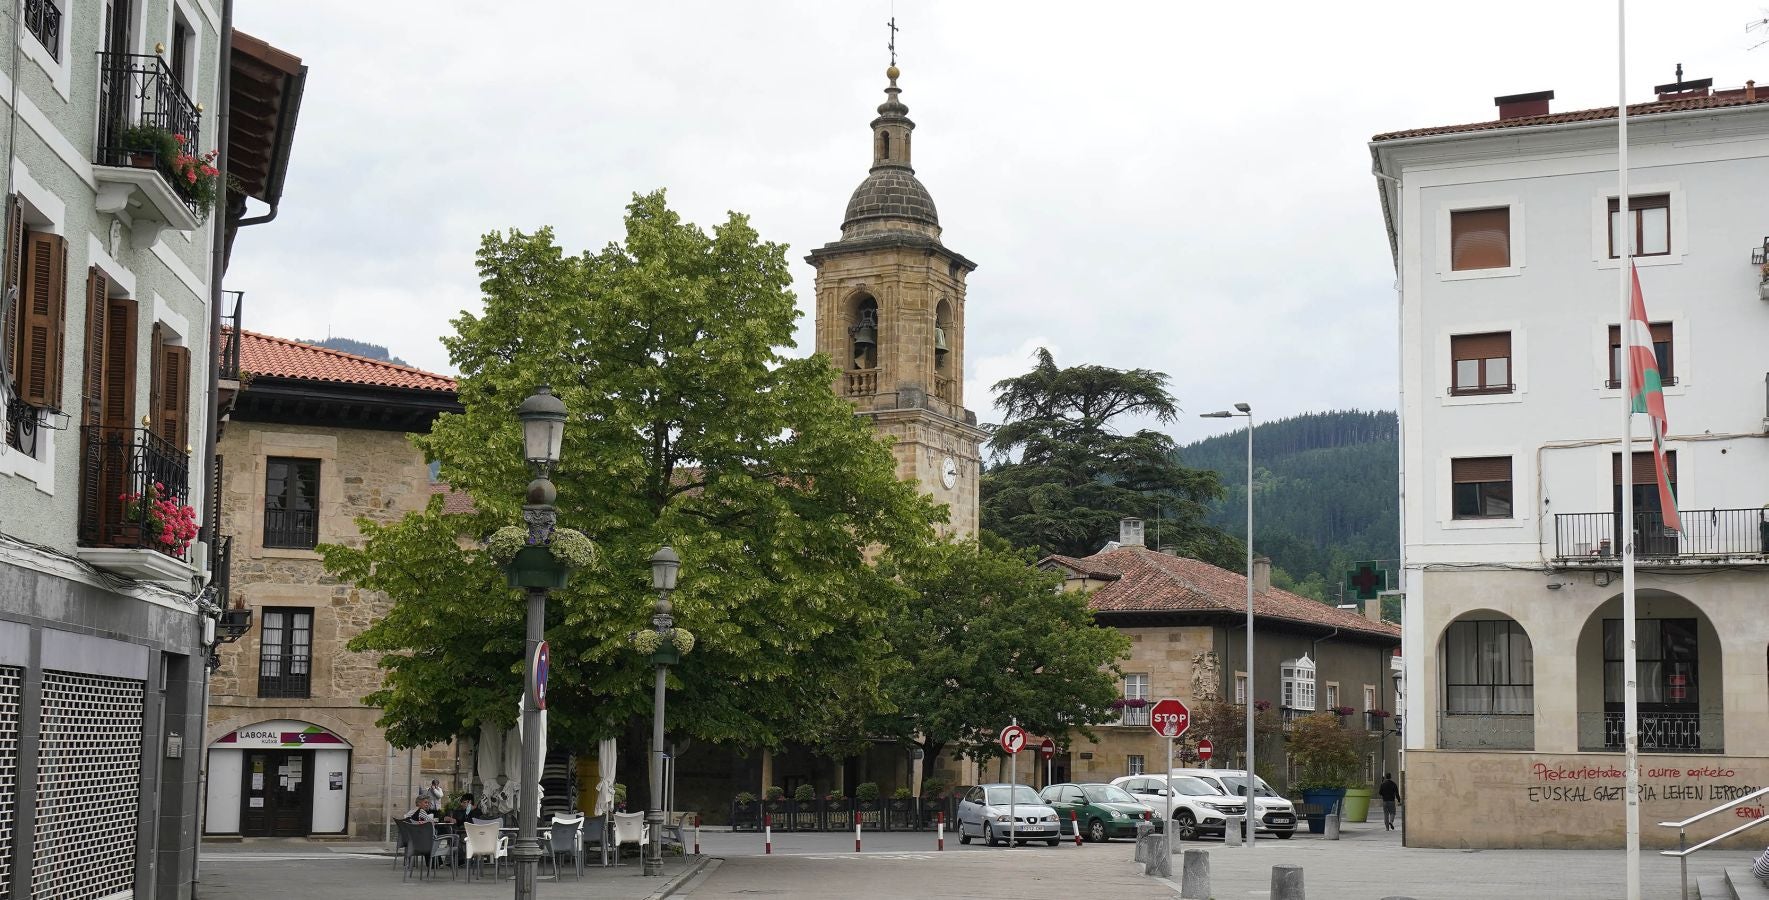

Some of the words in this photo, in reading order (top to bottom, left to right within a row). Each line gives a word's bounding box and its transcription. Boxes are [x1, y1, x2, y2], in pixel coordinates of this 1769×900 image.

[1154, 713, 1187, 723] STOP
[240, 731, 278, 739] LABORAL
[1648, 768, 1681, 778] aurre
[1528, 785, 1592, 802] EUSKAL
[1593, 784, 1657, 803] GAZTRIA
[1663, 785, 1704, 801] LEHEN
